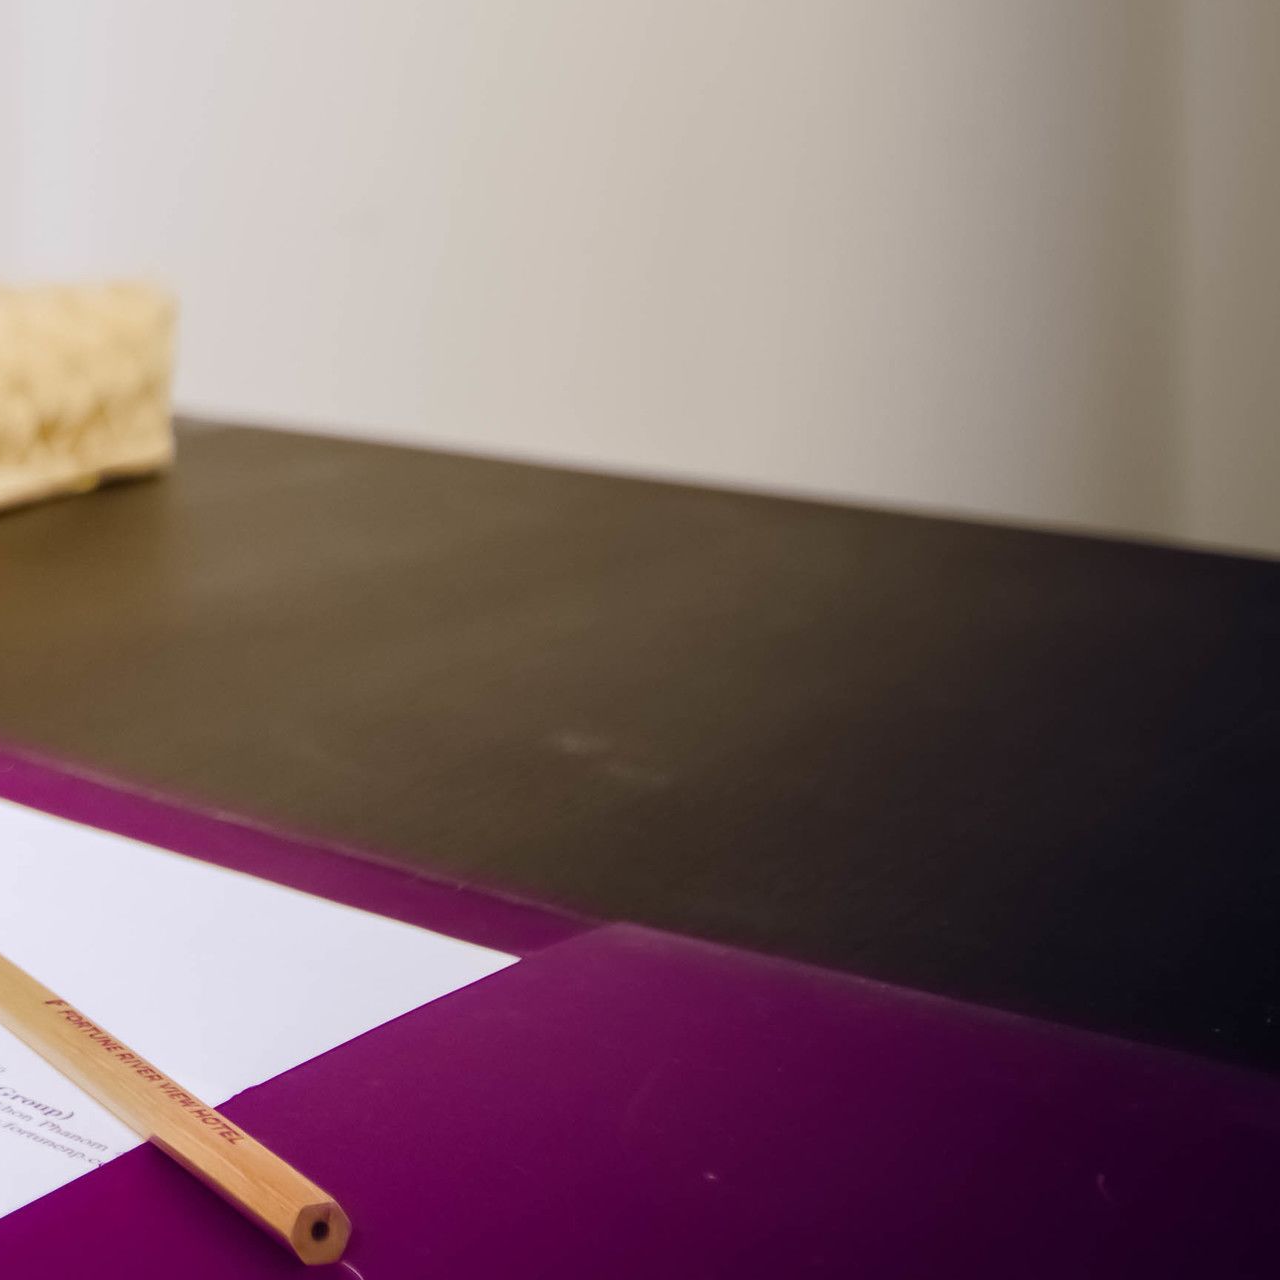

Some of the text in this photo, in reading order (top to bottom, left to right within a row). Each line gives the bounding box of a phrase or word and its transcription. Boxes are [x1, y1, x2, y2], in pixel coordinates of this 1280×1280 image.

[58, 1009, 123, 1053] FORTUNE
[115, 1048, 163, 1082] RIVER
[159, 1081, 199, 1111] VIEW
[190, 1109, 245, 1145] HOTEL
[40, 1119, 109, 1152] Phanom
